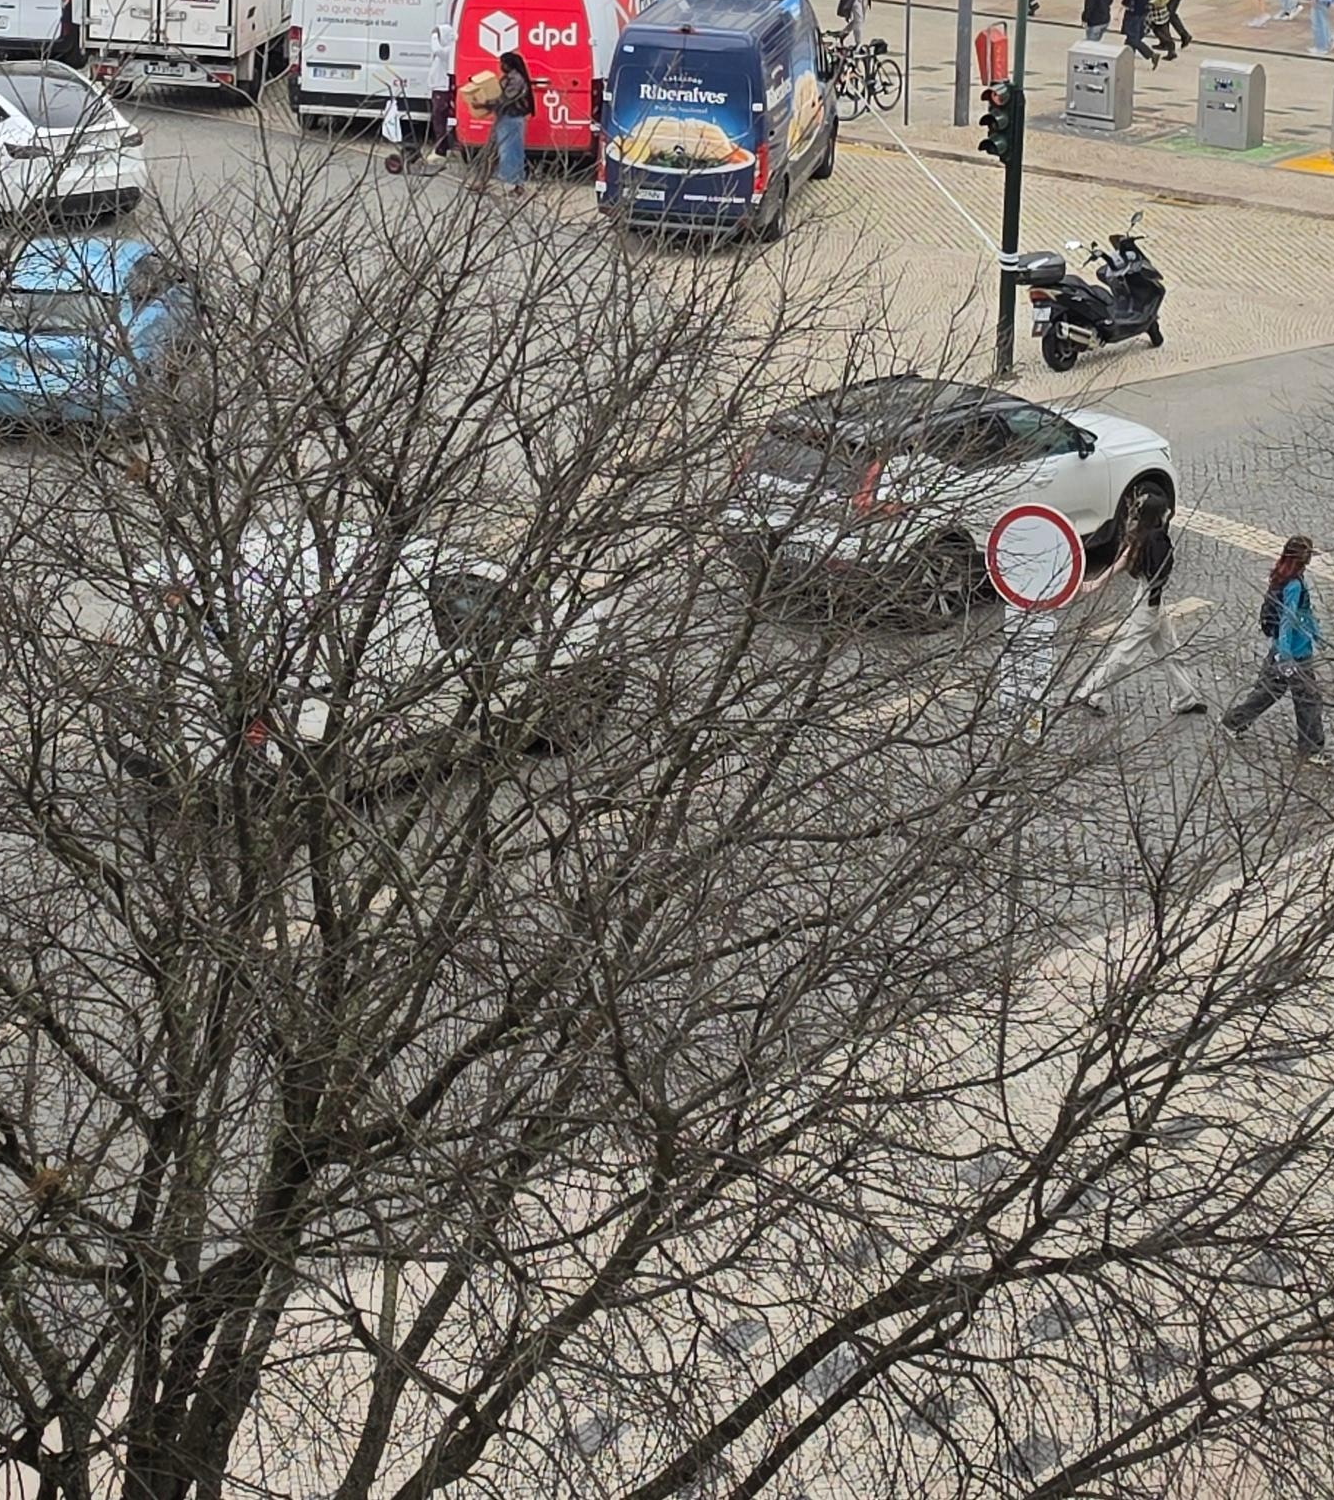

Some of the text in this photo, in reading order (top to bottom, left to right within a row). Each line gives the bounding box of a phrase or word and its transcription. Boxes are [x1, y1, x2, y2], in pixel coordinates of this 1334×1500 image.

[317, 4, 386, 16] ao que quiser
[528, 21, 577, 52] dpd
[639, 83, 728, 105] Riberalves
